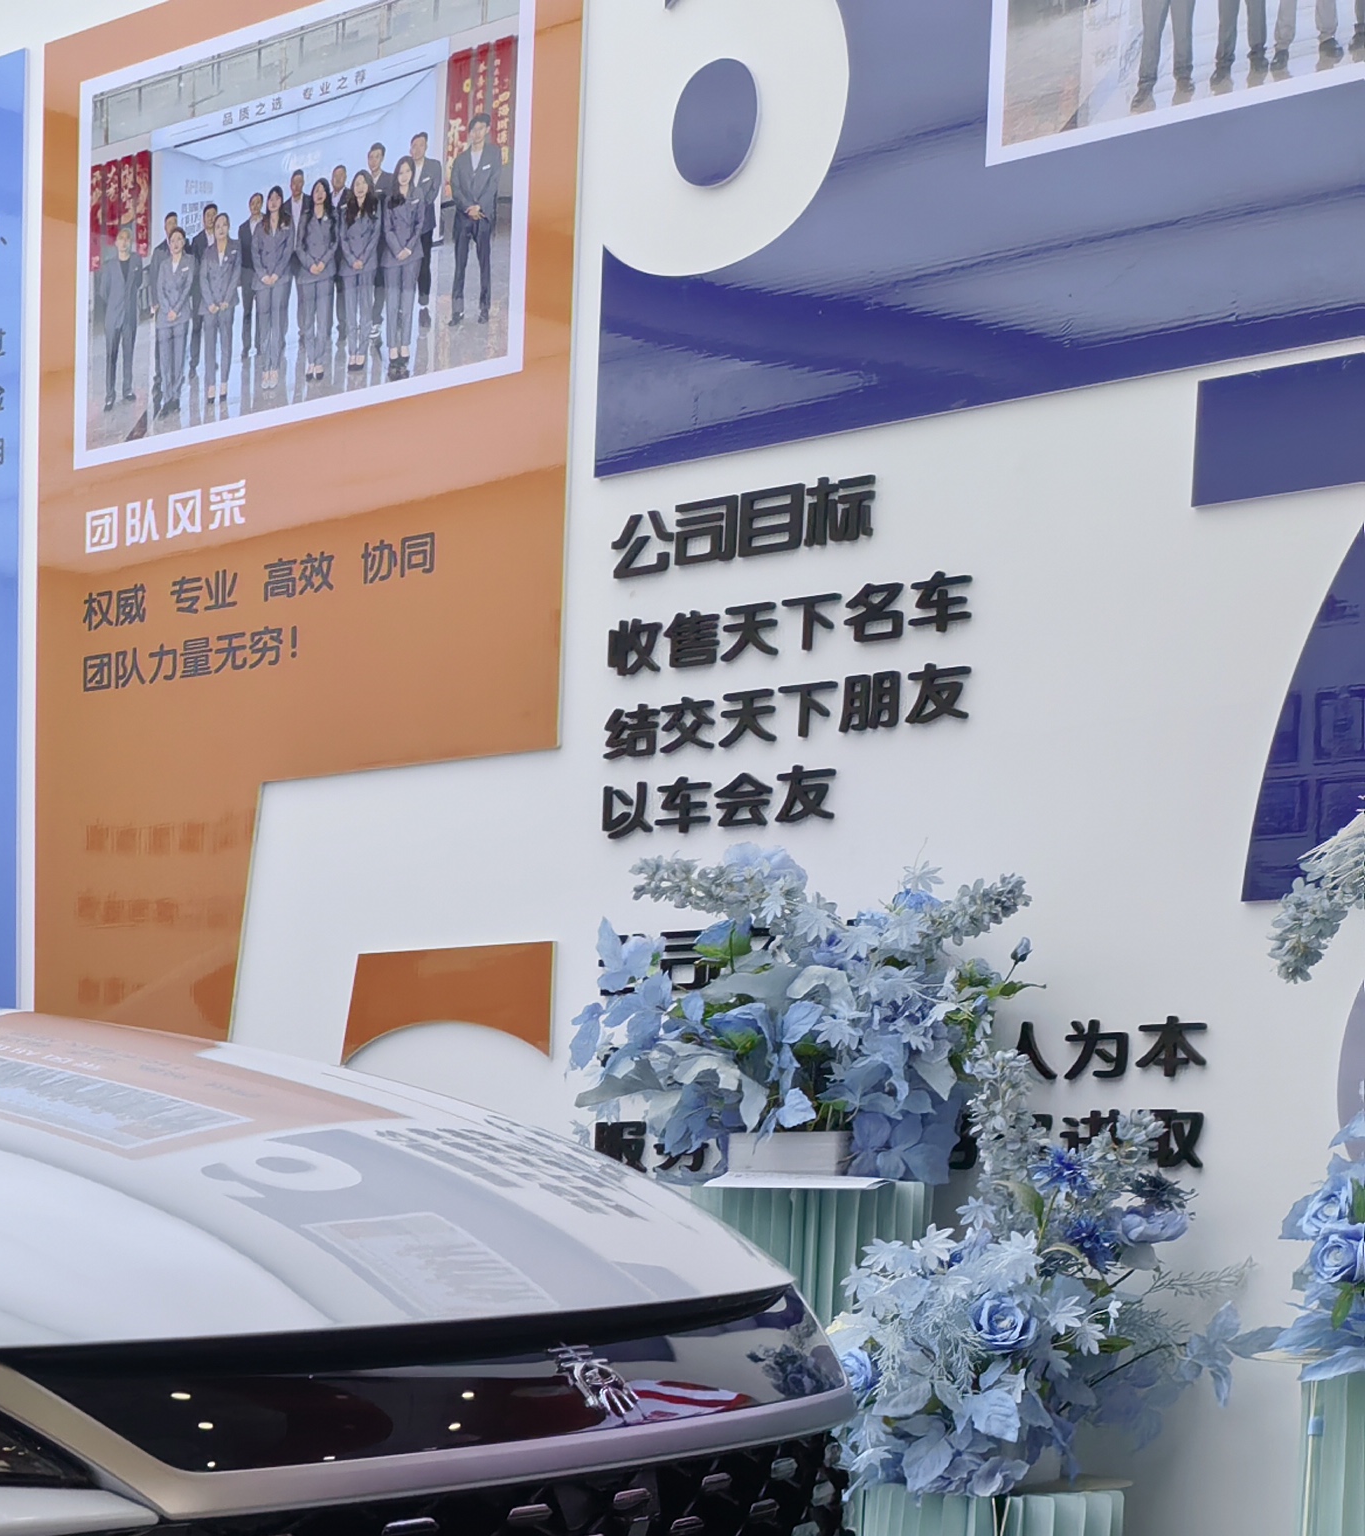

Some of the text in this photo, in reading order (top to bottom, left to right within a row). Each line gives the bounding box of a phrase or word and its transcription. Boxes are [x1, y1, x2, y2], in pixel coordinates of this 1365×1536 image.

[84, 479, 247, 554] 团队风采
[610, 474, 876, 580] 公司目标
[81, 531, 435, 632] 权威 专业 高效 协同
[607, 570, 973, 677] 收售天下名车
[602, 662, 972, 761] 结交天下朋友
[601, 764, 837, 840] 以车会友
